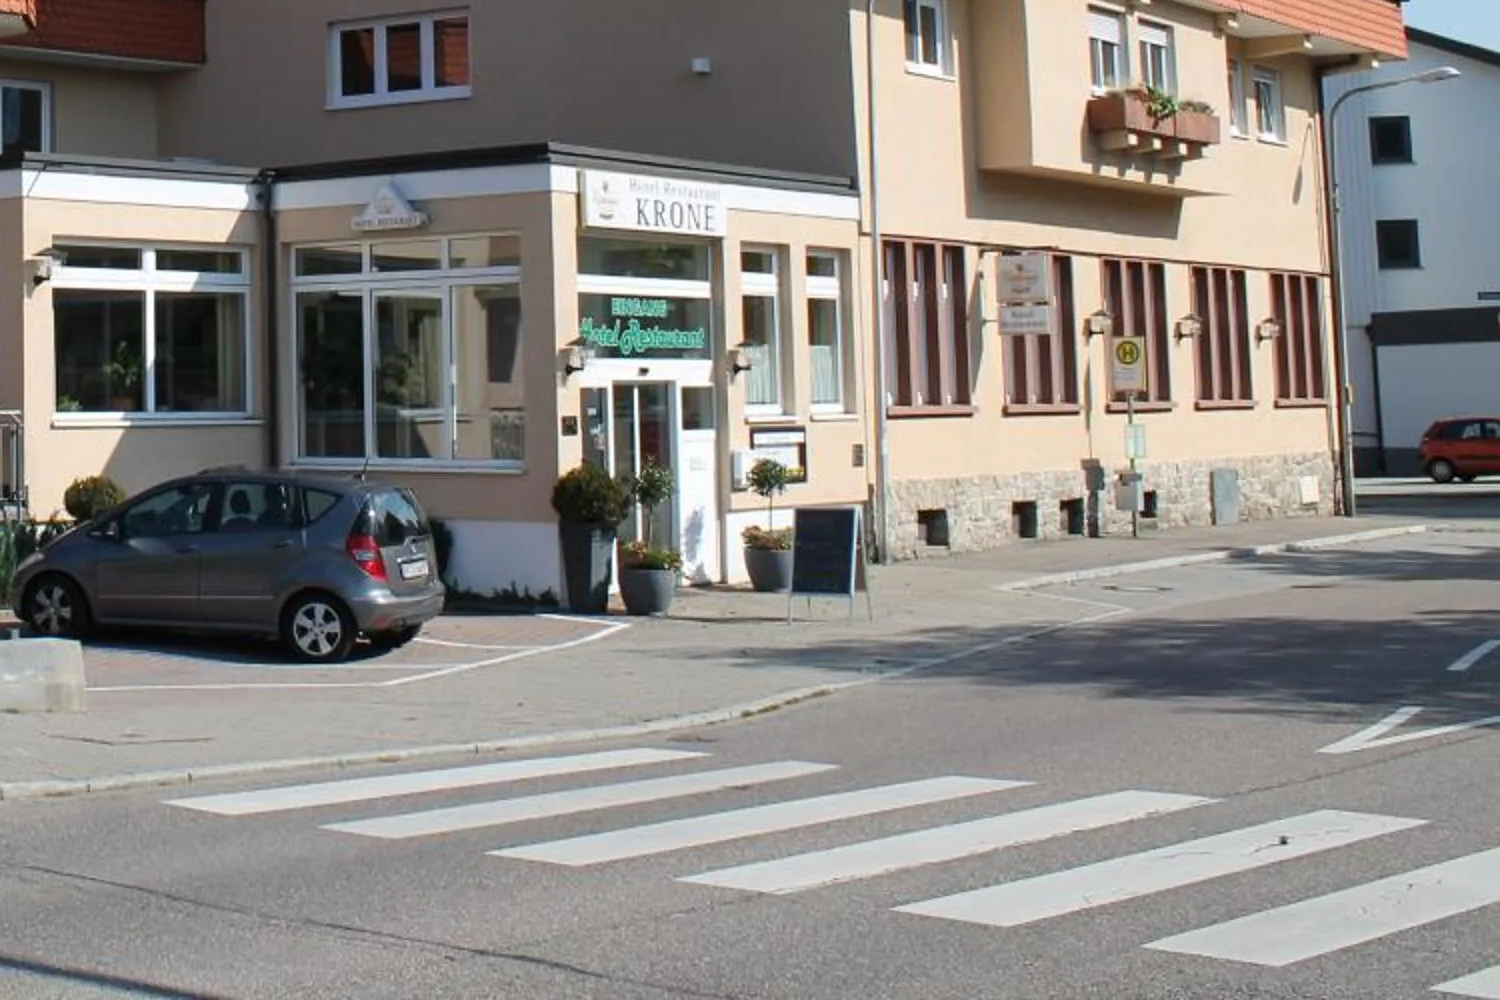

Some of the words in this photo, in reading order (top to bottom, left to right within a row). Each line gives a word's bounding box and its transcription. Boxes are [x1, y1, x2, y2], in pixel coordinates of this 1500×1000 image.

[635, 197, 717, 232] KRONE
[580, 315, 620, 347] Hotel
[620, 318, 706, 355] Restaurant
